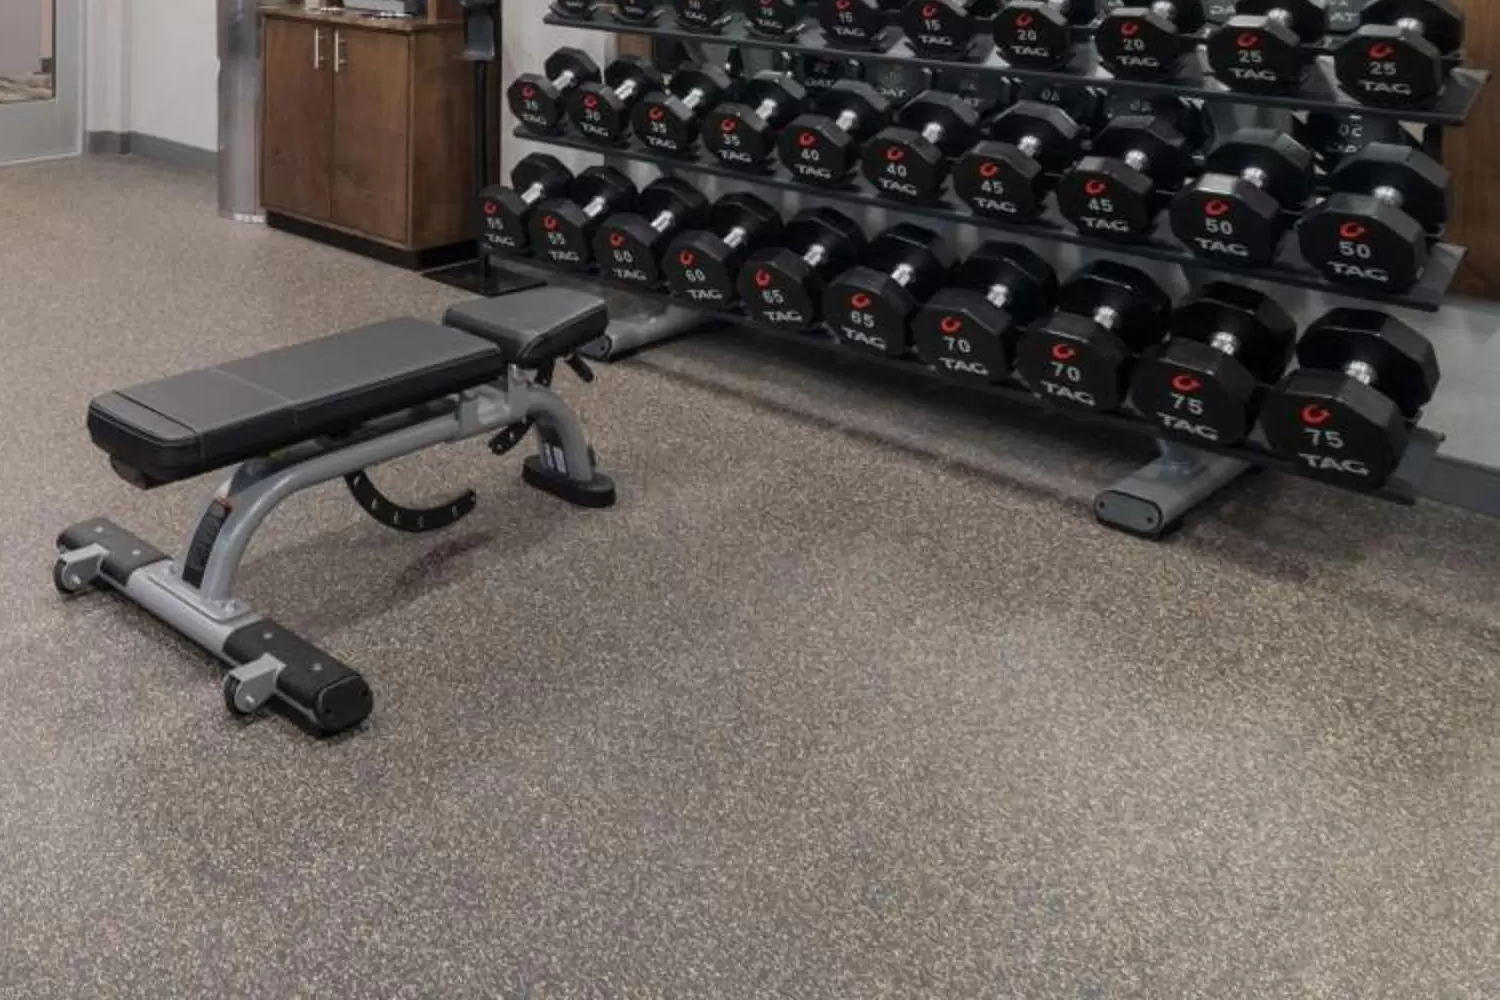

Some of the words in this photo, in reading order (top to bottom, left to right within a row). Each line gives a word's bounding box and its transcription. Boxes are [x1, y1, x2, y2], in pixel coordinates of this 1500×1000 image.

[833, 26, 865, 38] TAG
[918, 34, 953, 46] TAG
[1011, 45, 1049, 57] TAG
[1239, 51, 1263, 64] 25
[1117, 55, 1160, 67] TAG
[1228, 67, 1277, 81] TAG
[1369, 62, 1397, 76] 25
[1359, 79, 1412, 95] TAG
[646, 136, 676, 150] TAG
[723, 133, 741, 146] 35
[719, 150, 752, 163] TAG
[795, 164, 832, 179] TAG
[886, 164, 907, 177] 40
[879, 177, 917, 196] TAG
[981, 180, 1004, 195] 45
[973, 197, 1017, 213] TAG
[1088, 198, 1113, 213] 45
[1080, 216, 1130, 232] TAG
[1205, 218, 1233, 235] 50
[484, 233, 516, 248] TAG
[1194, 237, 1248, 256] TAG
[548, 250, 580, 262] TAG
[1339, 241, 1371, 259] 50
[612, 267, 647, 281] TAG
[1327, 260, 1389, 282] TAG
[686, 288, 723, 300] TAG
[764, 310, 803, 321] TAG
[850, 311, 876, 328] 65
[842, 326, 888, 350] TAG
[942, 335, 972, 353] 70
[938, 357, 989, 376] TAG
[1050, 362, 1081, 382] 70
[1040, 379, 1096, 406] TAG
[1170, 393, 1205, 415] 75
[1157, 411, 1219, 441] TAG
[1303, 427, 1344, 449] 75
[1298, 452, 1371, 476] TAG
